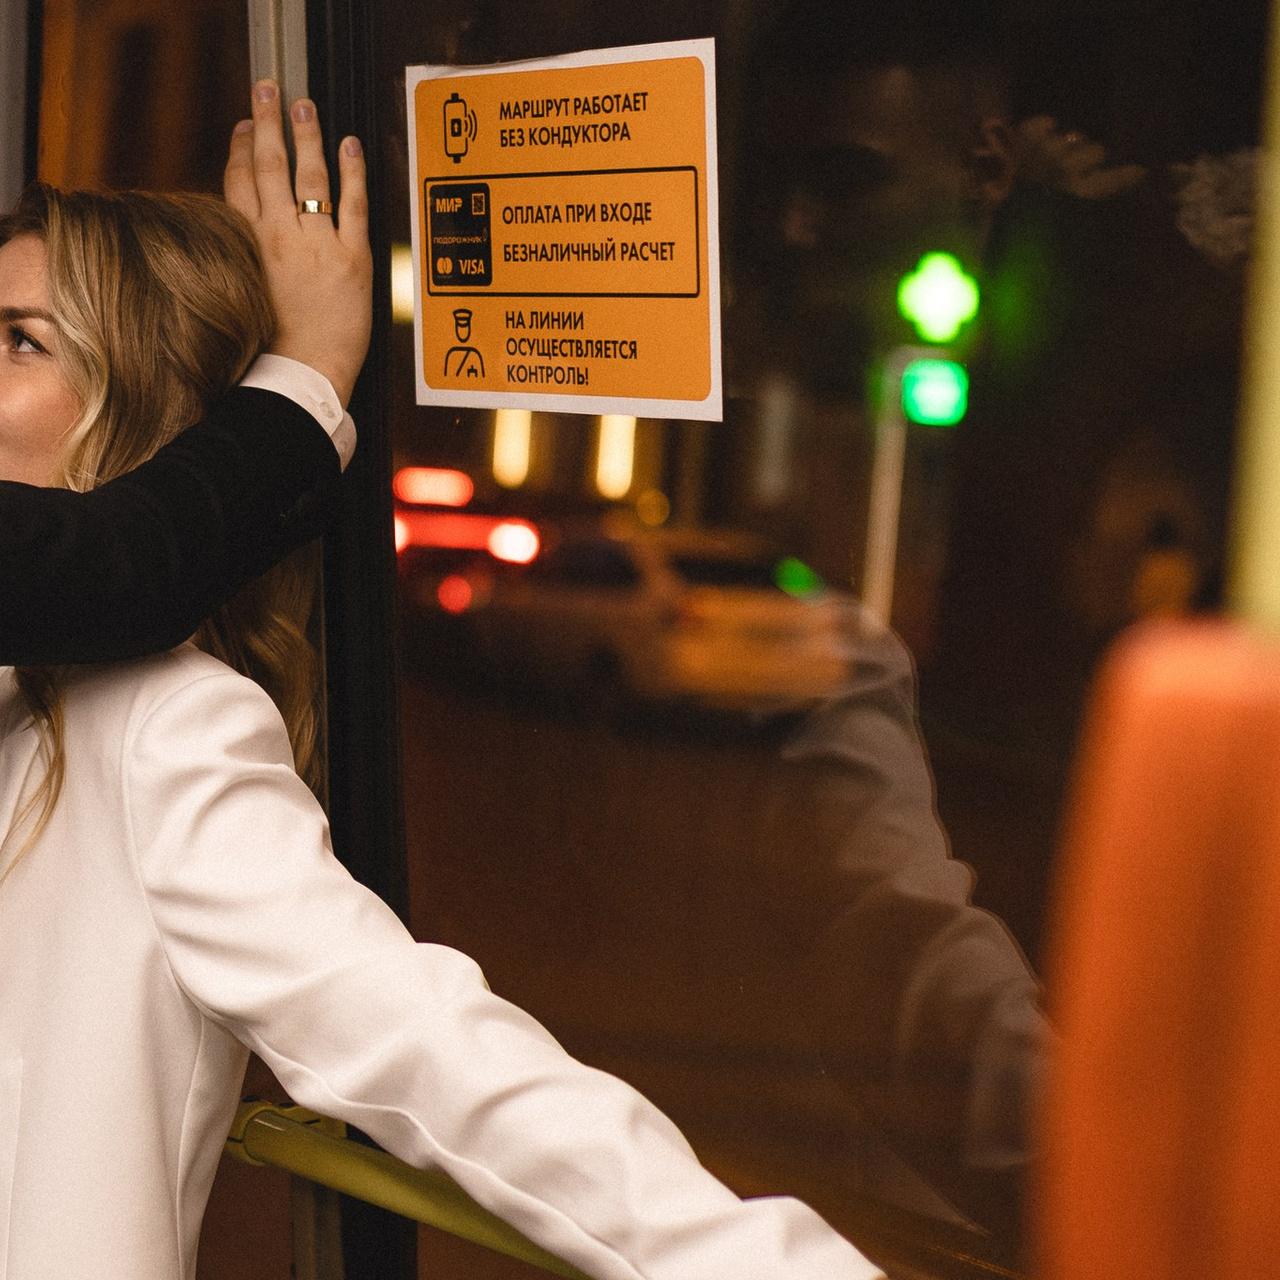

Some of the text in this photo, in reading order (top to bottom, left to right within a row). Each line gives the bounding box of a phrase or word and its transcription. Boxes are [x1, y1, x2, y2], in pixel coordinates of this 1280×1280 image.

[500, 92, 648, 120] МАРШРУТ РАБОТАЕТ
[500, 122, 631, 148] БЕЗ КОНДУКТОРА
[435, 197, 463, 213] МИР
[502, 202, 652, 225] ОПЛАТА ПРИ ВХОДЕ
[503, 237, 676, 262] БЕЗНАЛИЧНЫЙ РАСЧЕТ
[458, 259, 485, 275] VISA
[505, 311, 584, 330] НА ЛИНИИ
[506, 338, 638, 360] ОСУЩЕСТВЛЯЕТСЯ
[507, 364, 589, 386] КОНТРОЛЬ!
